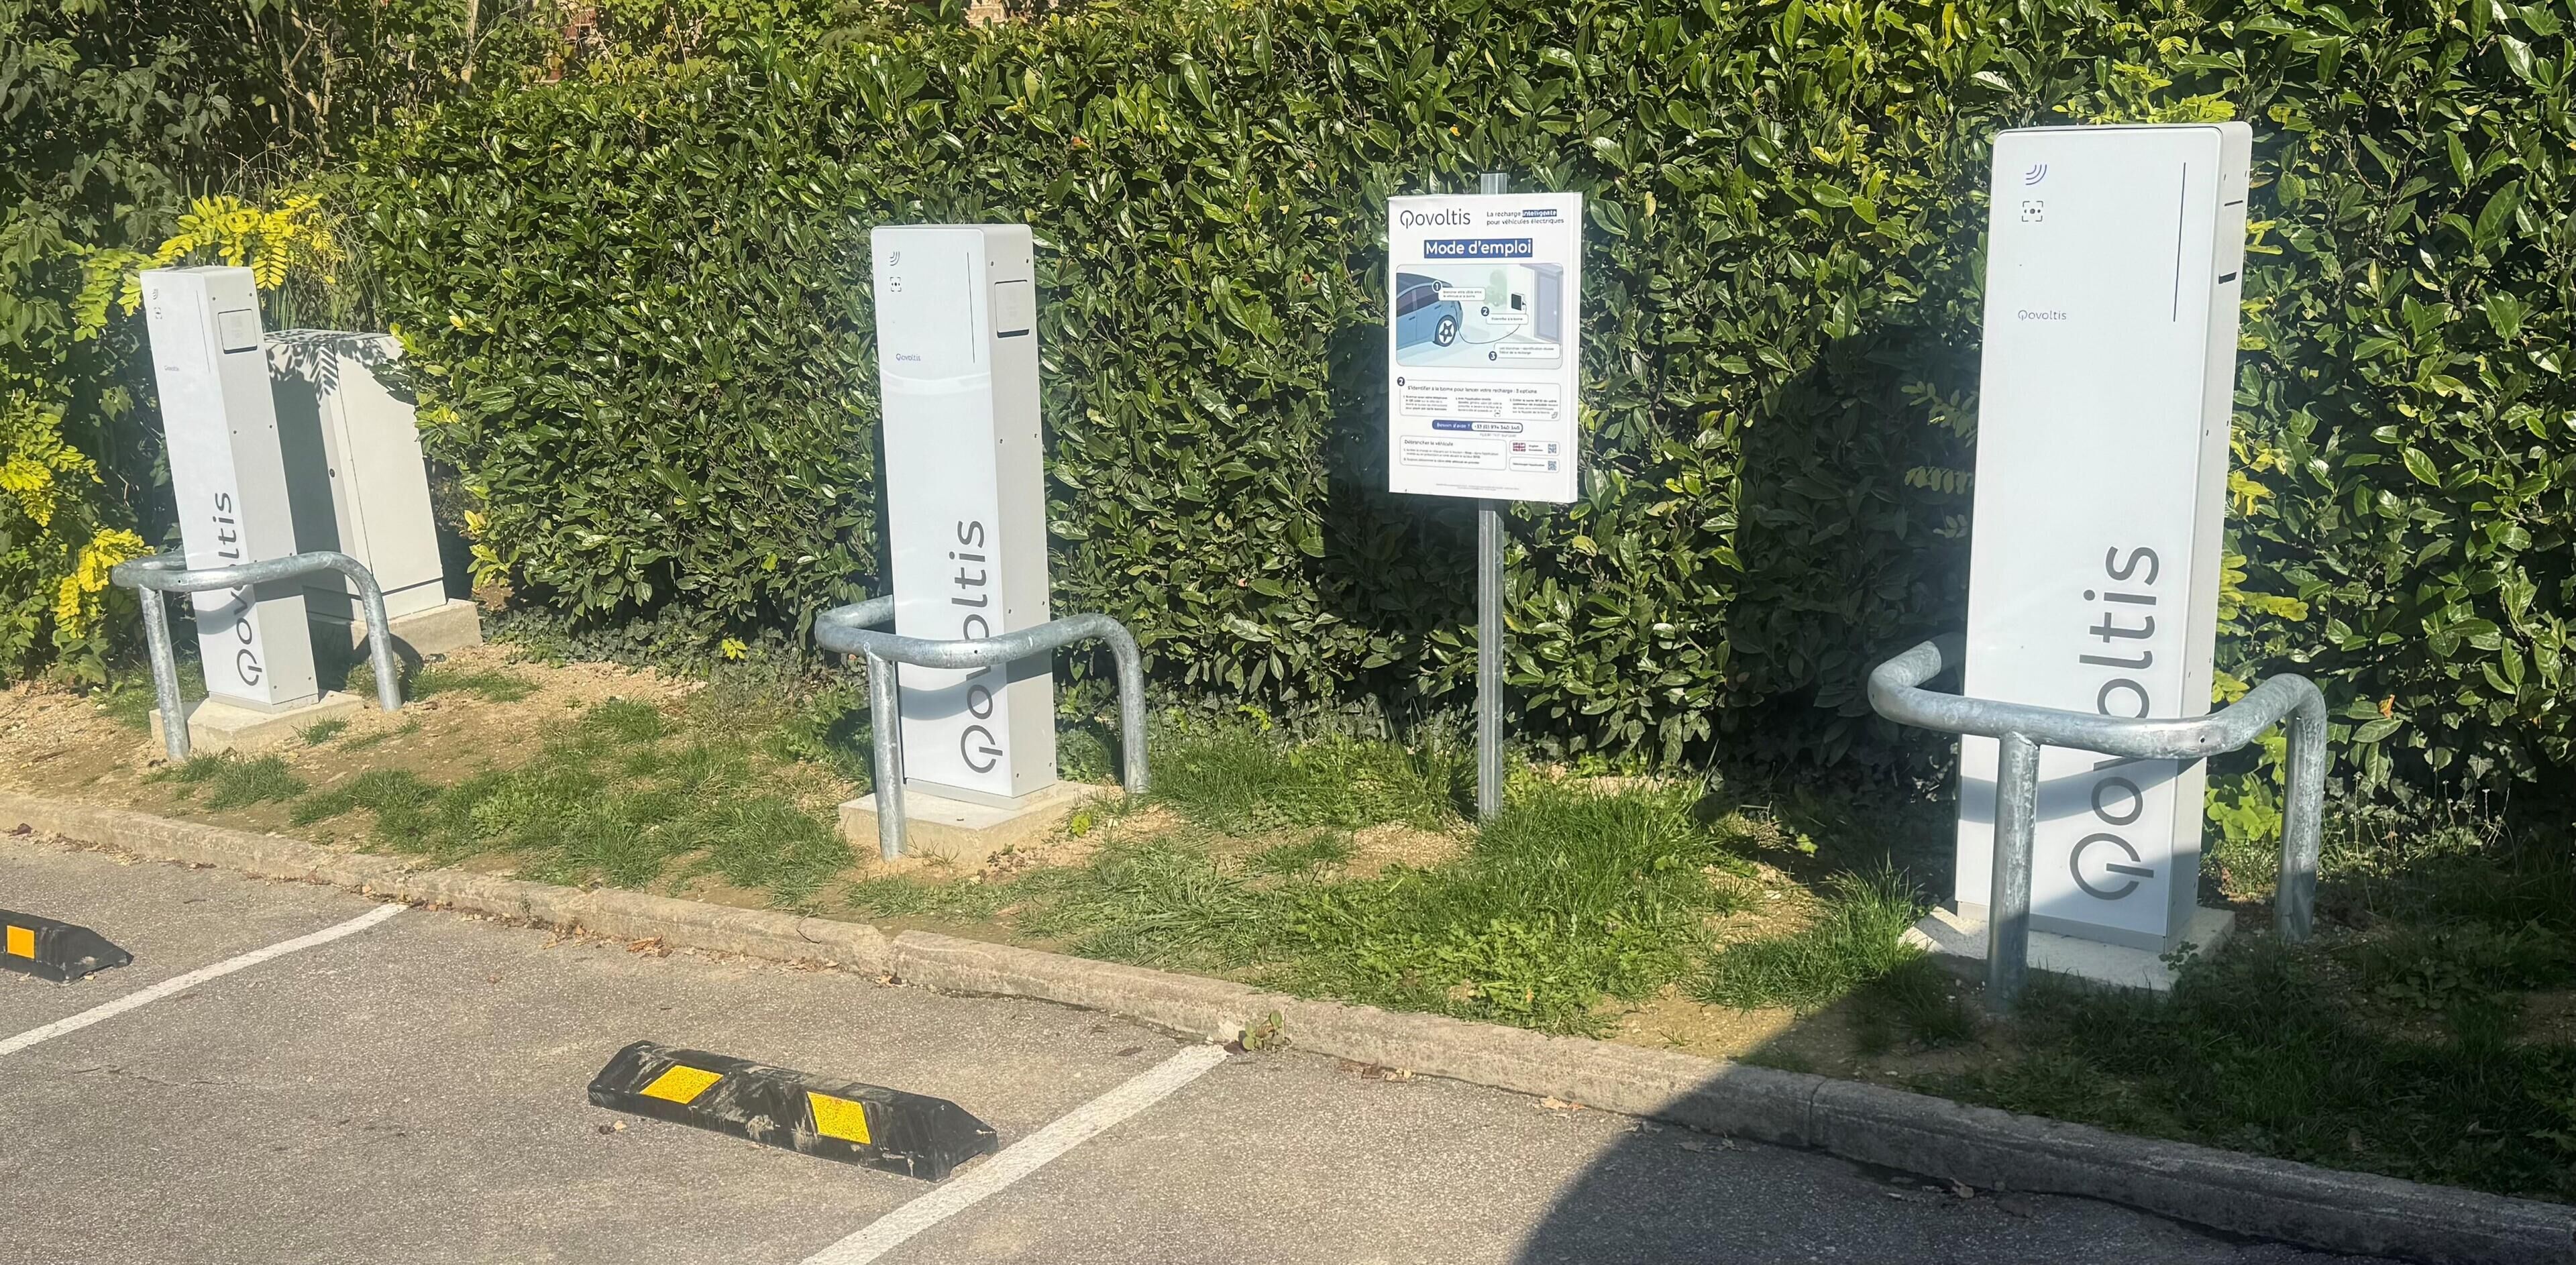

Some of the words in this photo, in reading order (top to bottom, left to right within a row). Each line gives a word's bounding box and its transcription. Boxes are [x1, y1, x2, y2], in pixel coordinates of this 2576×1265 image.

[1400, 208, 1470, 229] Qovoltis
[1426, 240, 1465, 255] Mode
[1468, 239, 1532, 257] d'emploi
[2018, 309, 2067, 321] Qovoltis
[213, 492, 263, 686] Qovltis
[2070, 545, 2159, 901] Qooltis
